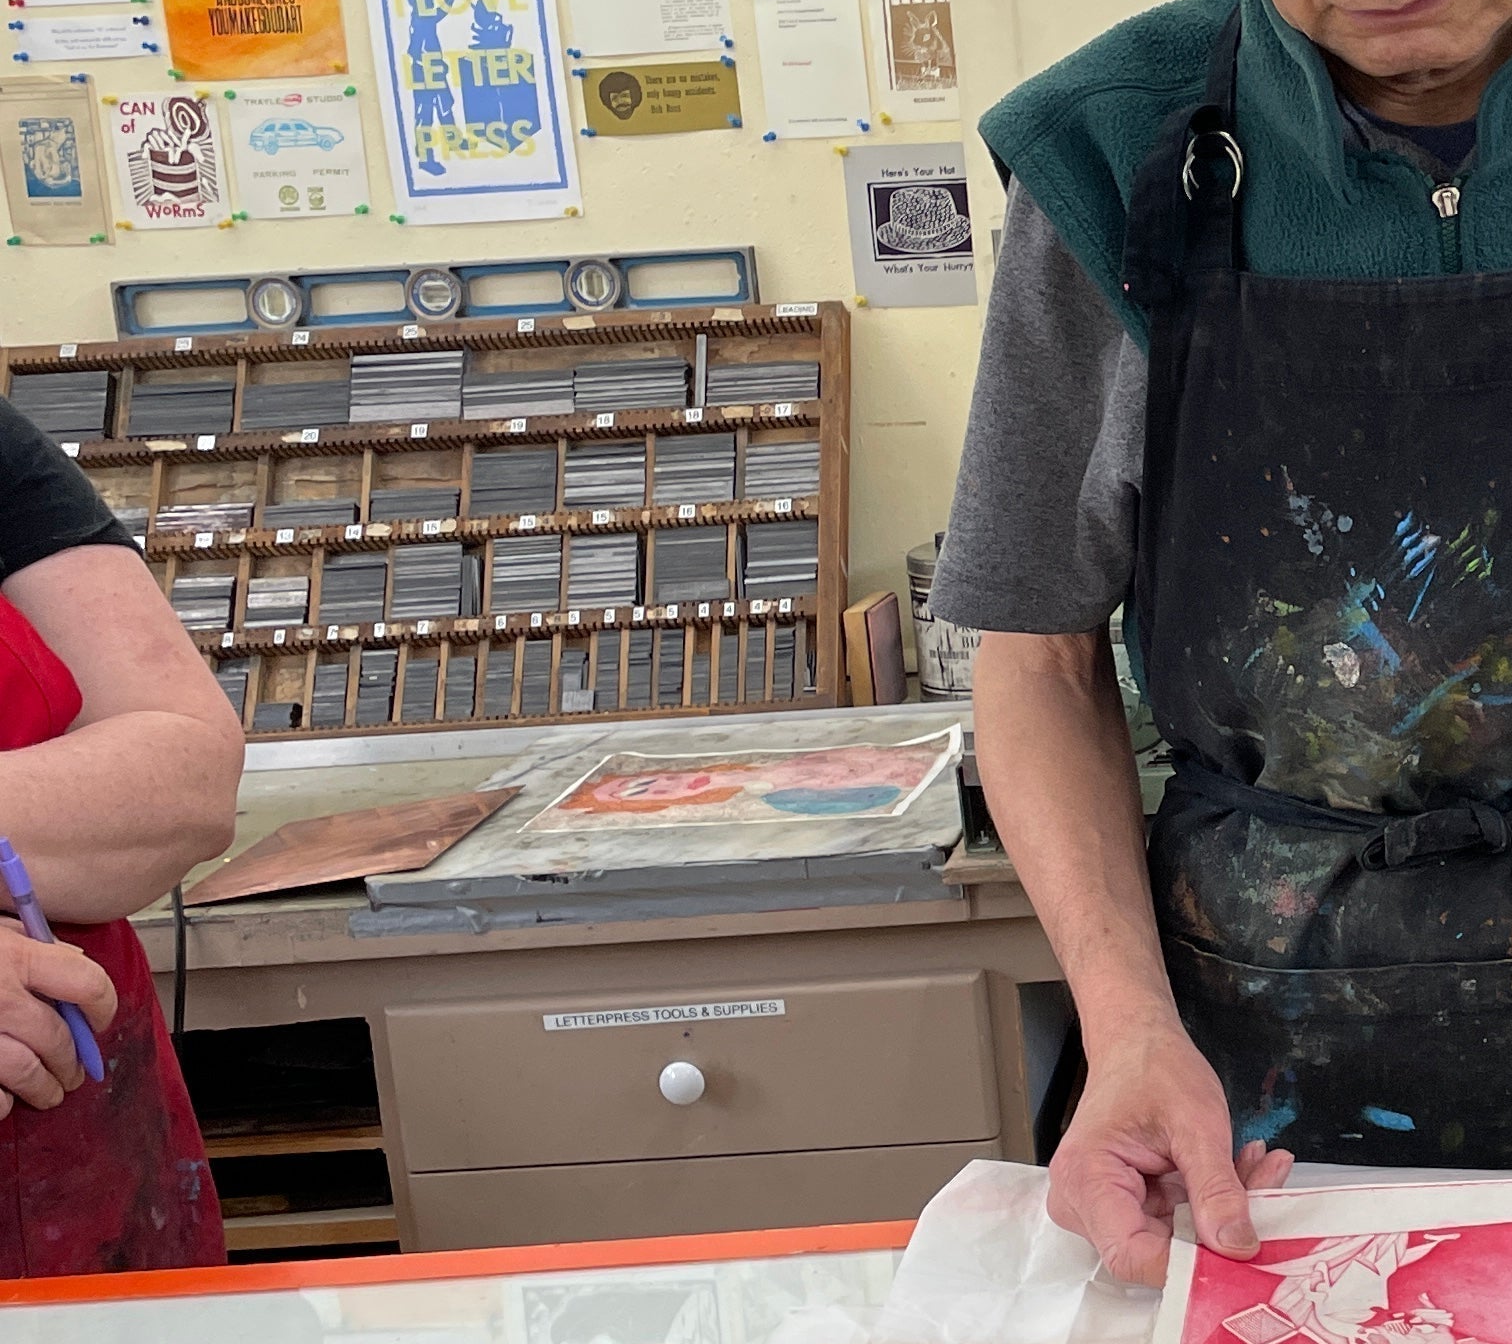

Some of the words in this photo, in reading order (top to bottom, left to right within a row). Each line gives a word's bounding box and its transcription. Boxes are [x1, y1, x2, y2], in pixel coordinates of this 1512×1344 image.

[402, 48, 536, 90] LETTER
[645, 75, 663, 85] There
[306, 94, 343, 104] STUDIO
[120, 101, 155, 116] CAN
[121, 119, 136, 134] of
[415, 119, 537, 162] PRESS
[253, 169, 296, 178] PARKING
[312, 168, 349, 176] PERMIT
[881, 168, 909, 178] Here's
[913, 167, 934, 176] Your
[939, 166, 955, 175] Hat
[884, 263, 914, 274] What's
[918, 263, 938, 272] Your
[943, 262, 973, 272] Hurry?
[778, 305, 816, 315] LEADING
[521, 320, 532, 329] 25
[404, 326, 417, 336] 25
[293, 333, 308, 343] 24
[777, 405, 789, 415] 17
[598, 415, 610, 424] 18
[512, 421, 524, 430] 19
[413, 426, 426, 436] 19
[304, 432, 317, 441] 20
[777, 500, 789, 511] 16
[596, 513, 607, 522] 15
[522, 518, 534, 528] 15
[725, 604, 732, 614] 4
[753, 601, 761, 610] 4
[781, 600, 789, 609] 4
[555, 1010, 650, 1028] LETTERPRESS
[653, 1007, 698, 1021] TOOLS
[701, 1006, 710, 1017] &
[713, 1001, 778, 1017] SUPPLIES
